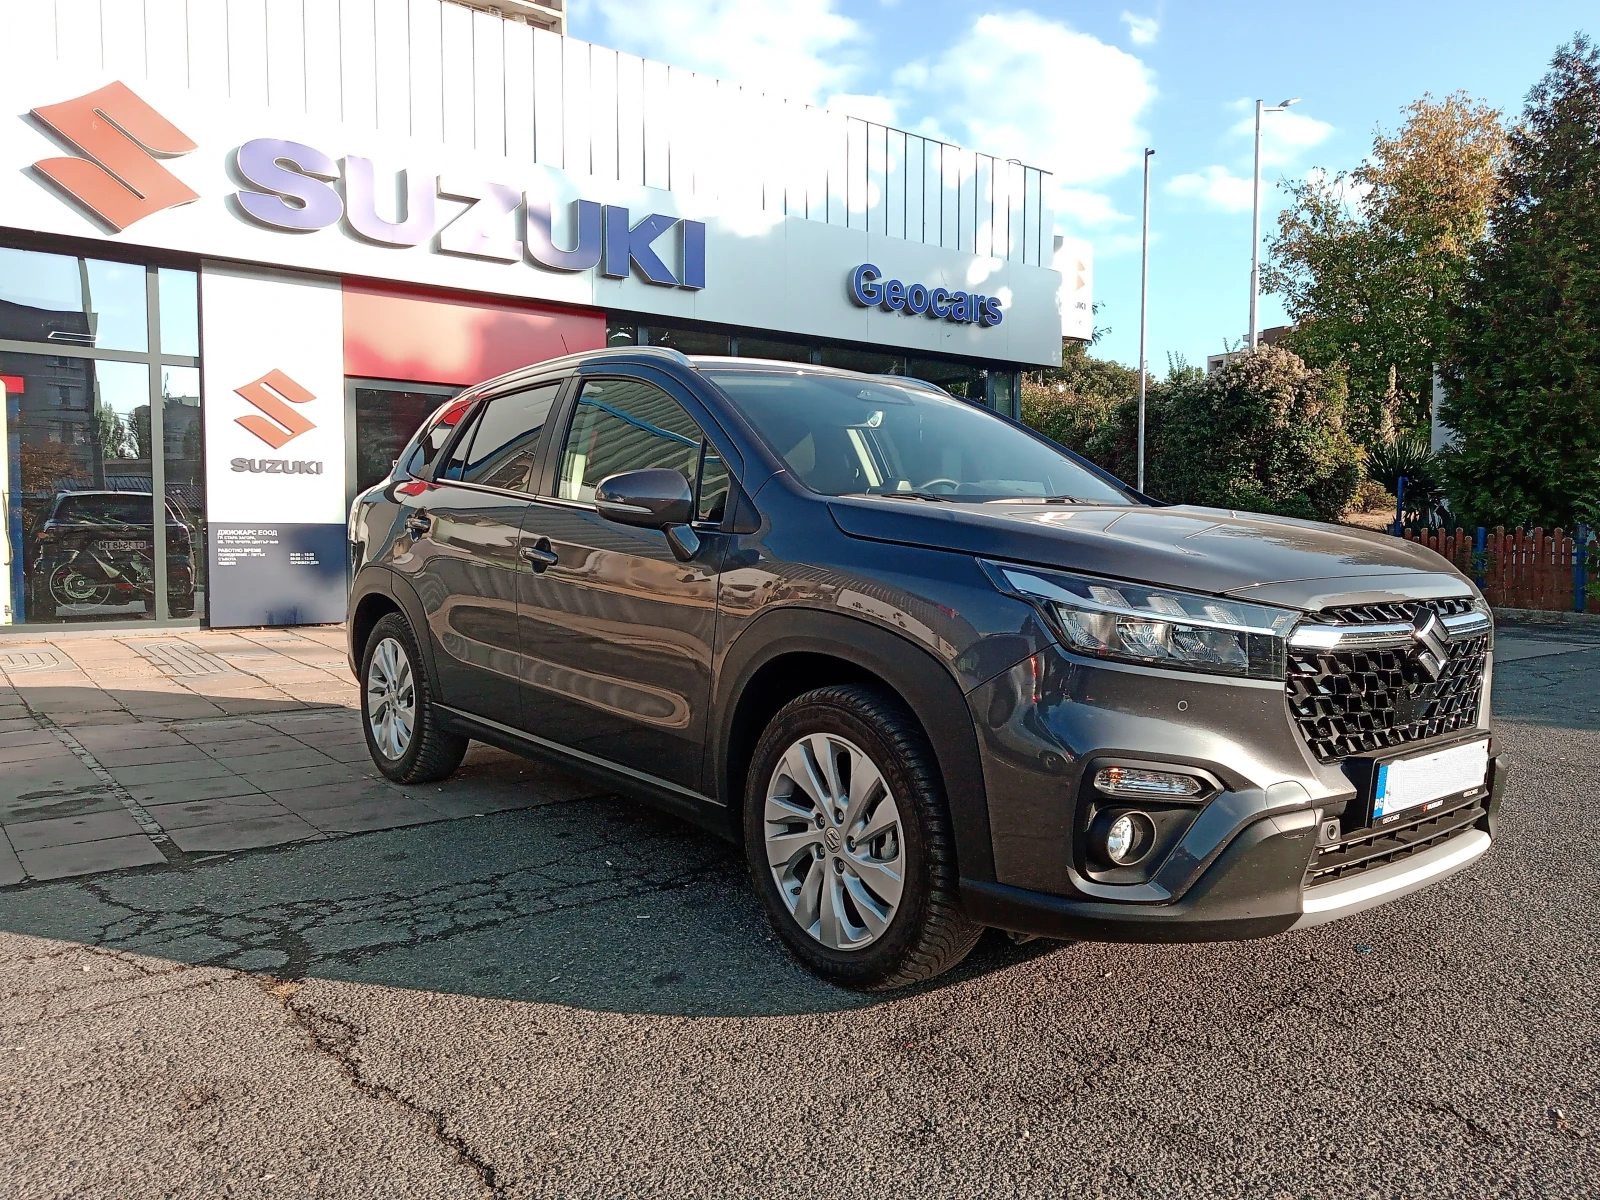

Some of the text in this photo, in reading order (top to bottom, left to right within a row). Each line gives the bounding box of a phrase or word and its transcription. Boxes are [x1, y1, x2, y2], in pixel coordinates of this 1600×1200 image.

[233, 137, 706, 290] SUZUKI
[851, 262, 1004, 327] Geocars
[230, 457, 324, 475] SUZUKI
